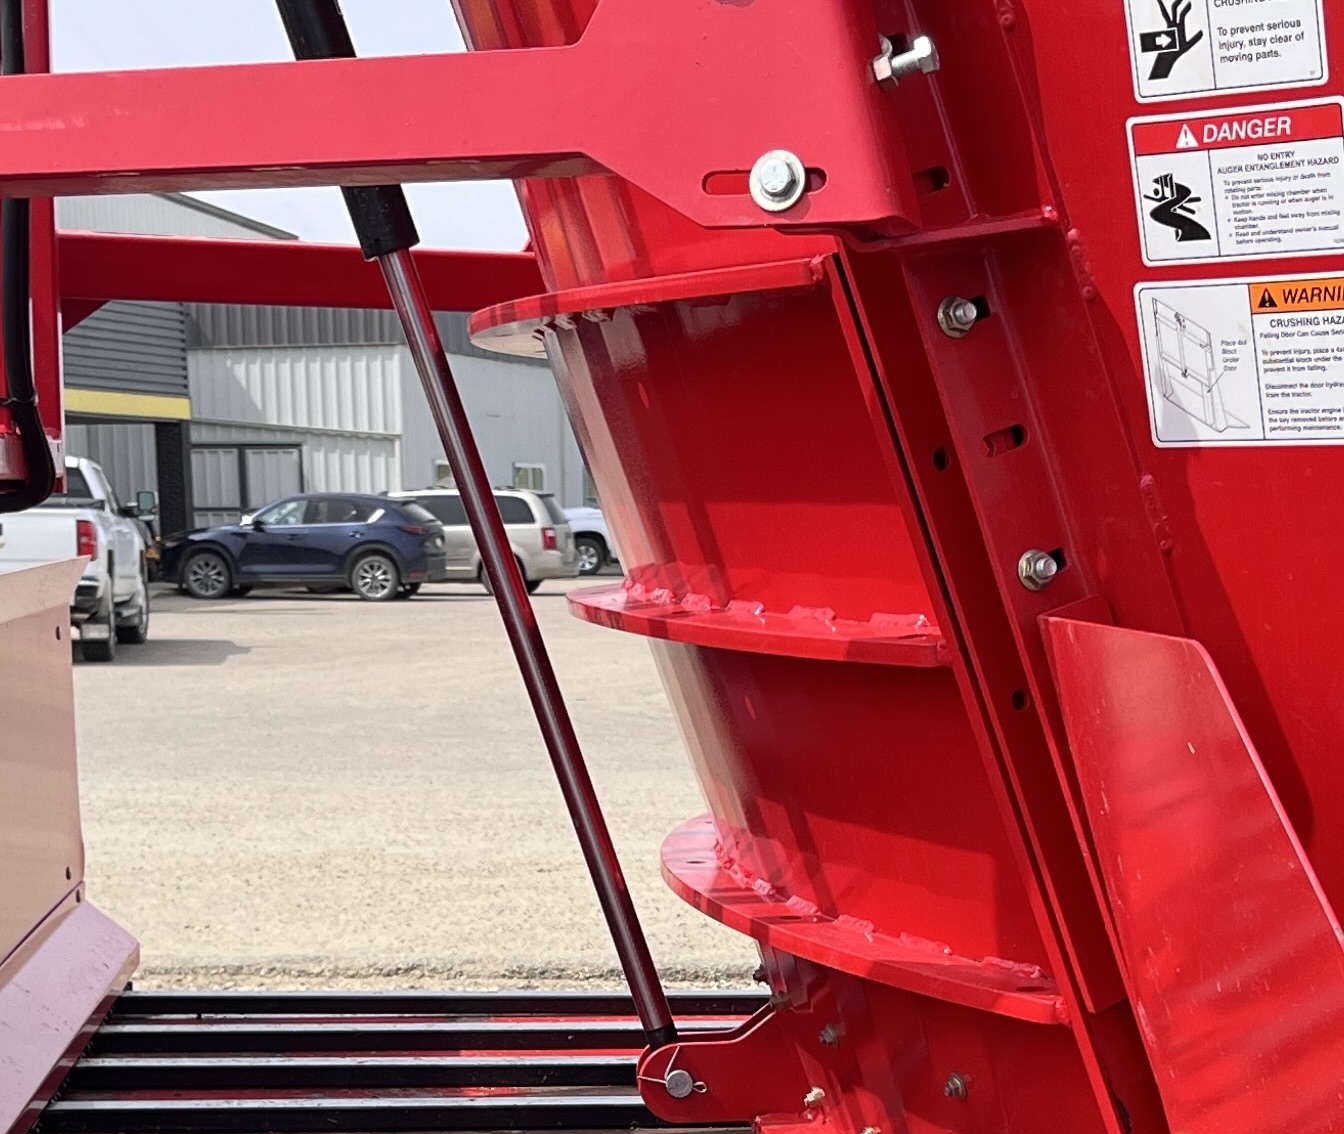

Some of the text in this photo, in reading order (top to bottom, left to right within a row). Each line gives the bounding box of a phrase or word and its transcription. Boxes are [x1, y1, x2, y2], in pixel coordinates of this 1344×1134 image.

[1217, 19, 1301, 36] To prevent serious
[1217, 31, 1304, 50] injury, stay clear of
[1219, 49, 1282, 62] moving parts.
[1203, 116, 1291, 143] DANGER
[1256, 151, 1294, 161] NO ENTRY
[1217, 156, 1339, 174] AUGER ENTANGLEMENT HAZARD
[1269, 317, 1320, 327] CRUSHING
